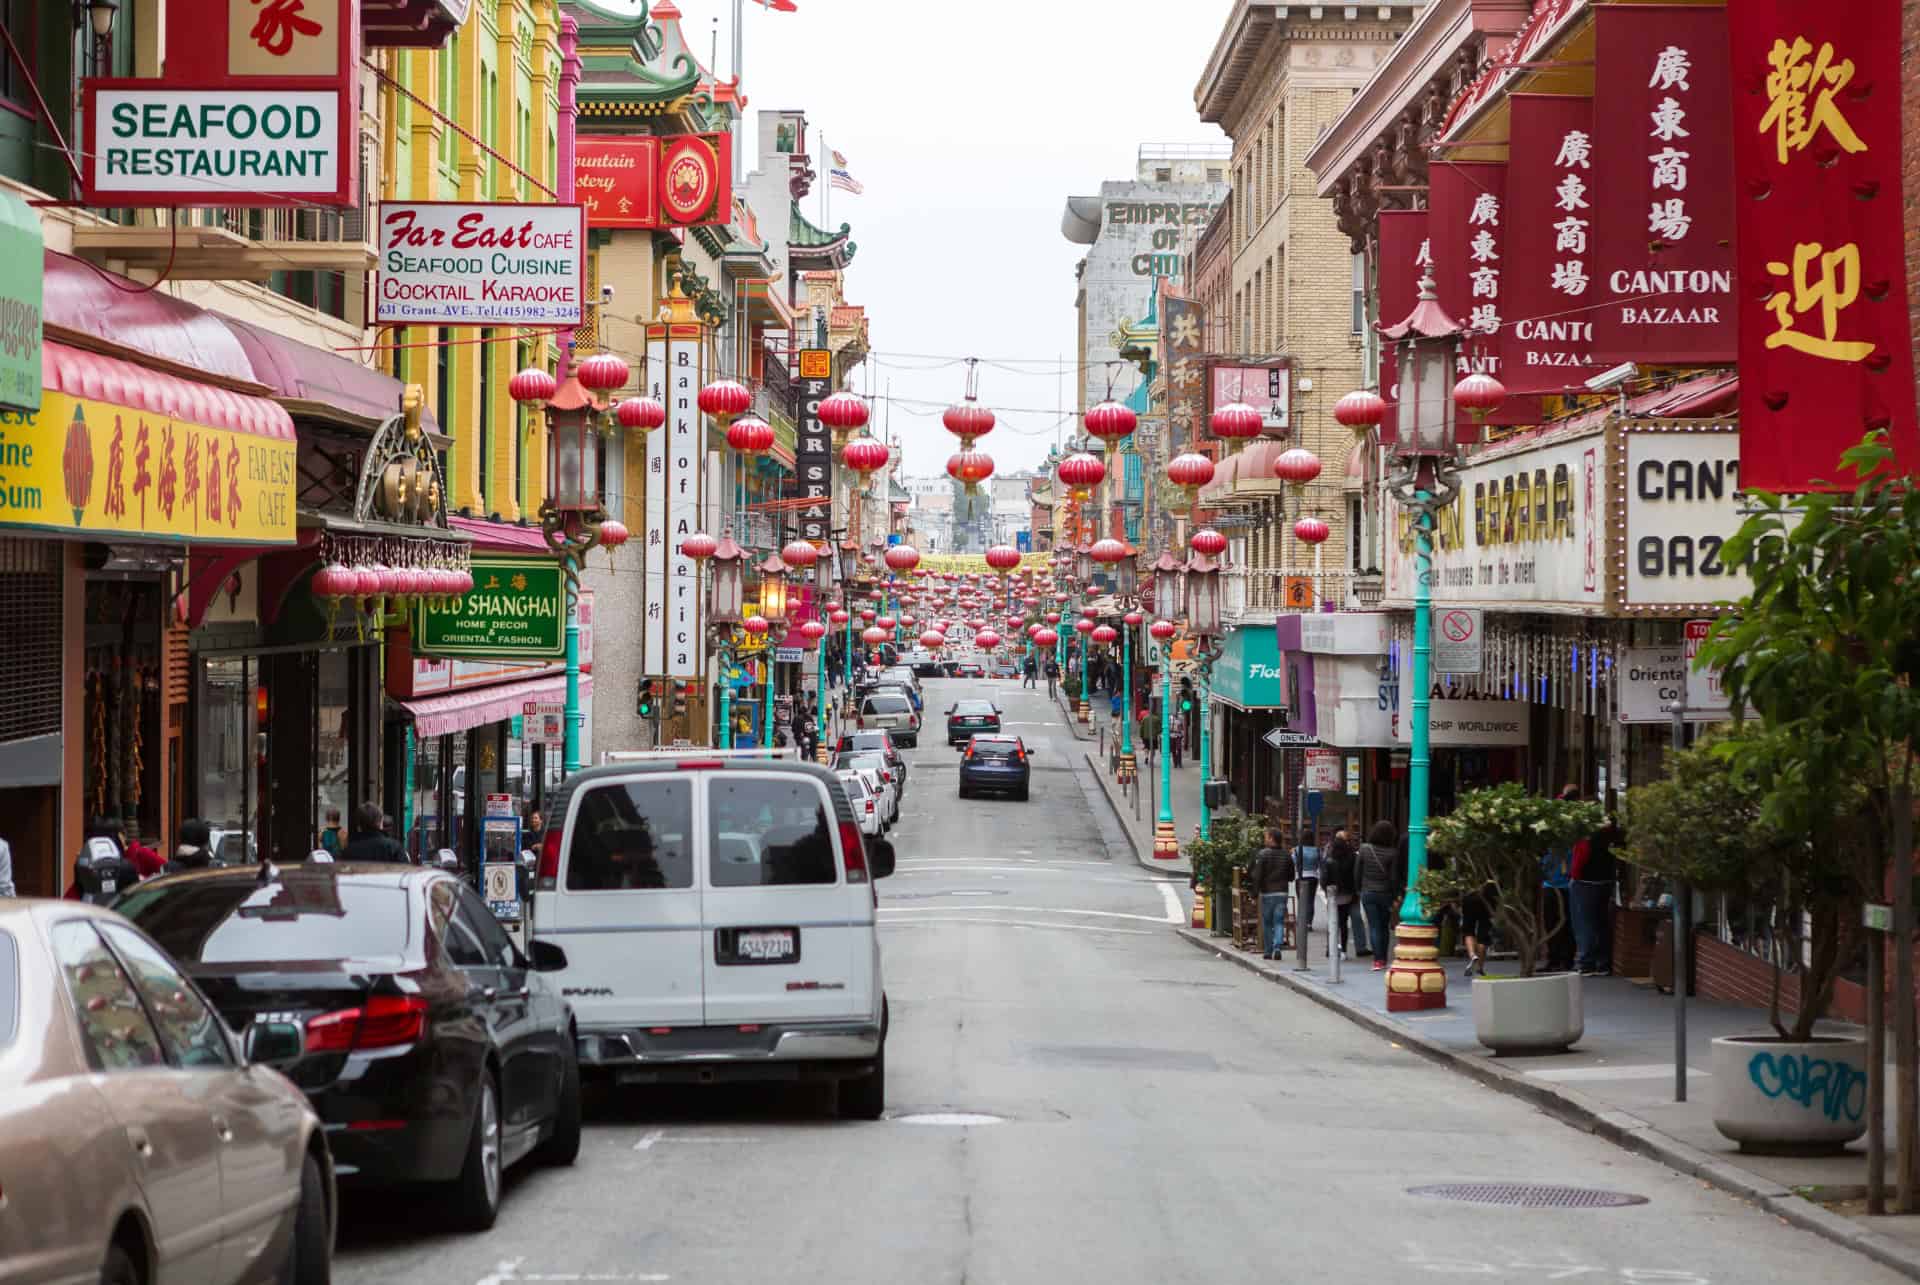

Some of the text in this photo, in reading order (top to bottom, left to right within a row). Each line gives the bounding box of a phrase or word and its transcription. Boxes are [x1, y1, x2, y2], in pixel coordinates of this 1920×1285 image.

[112, 103, 321, 139] SEAFOOD
[1649, 46, 1692, 240] 廣東商場
[107, 148, 328, 177] RESTAURANT
[575, 174, 616, 192] stery
[1759, 36, 1876, 362] 歡迎
[1551, 130, 1592, 296] 廣東商場
[385, 210, 573, 249] Far East CAFÉ
[1469, 193, 1502, 335] 廣東商場
[1610, 270, 1731, 294] CANTON
[402, 305, 436, 316] Grant
[1621, 307, 1720, 324] BAZAAR
[1515, 320, 1593, 341] CANT
[1456, 357, 1502, 374] ANT
[1526, 352, 1593, 367] BAZAA
[678, 351, 690, 434] Bank
[0, 432, 33, 468] ine
[248, 445, 297, 487] FAR EAST
[678, 456, 688, 494] of
[1638, 460, 1748, 500] CANT
[468, 595, 557, 617] SHANGHAI
[456, 621, 528, 630] HOME DECOR
[488, 629, 496, 637] &
[1692, 624, 1713, 636] TO
[442, 634, 542, 645] ORIENTAL FASHION
[1630, 669, 1685, 681] Orienta
[1429, 720, 1453, 732] SHIP
[1458, 720, 1520, 733] WORLDWIDE
[1280, 734, 1297, 742] ONE
